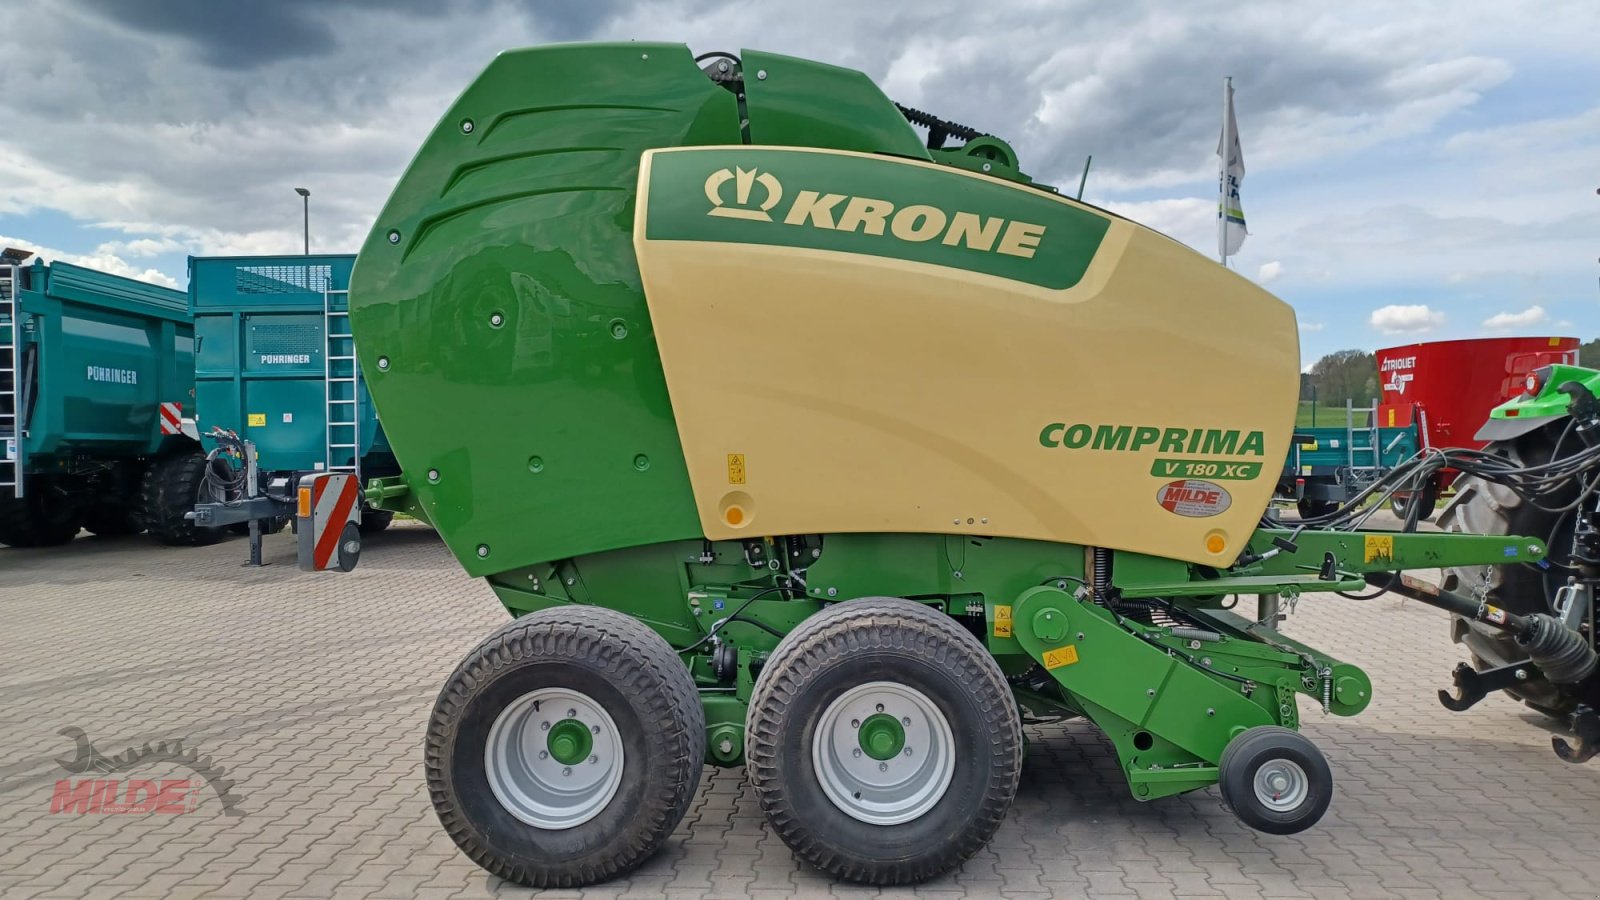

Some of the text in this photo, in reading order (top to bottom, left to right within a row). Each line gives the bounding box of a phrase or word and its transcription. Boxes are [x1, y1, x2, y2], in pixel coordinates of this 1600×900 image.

[784, 190, 1046, 259] KRONE
[1039, 423, 1264, 456] COMPRIMA
[1165, 462, 1251, 478] V 180 XC
[1164, 488, 1220, 505] MILDE
